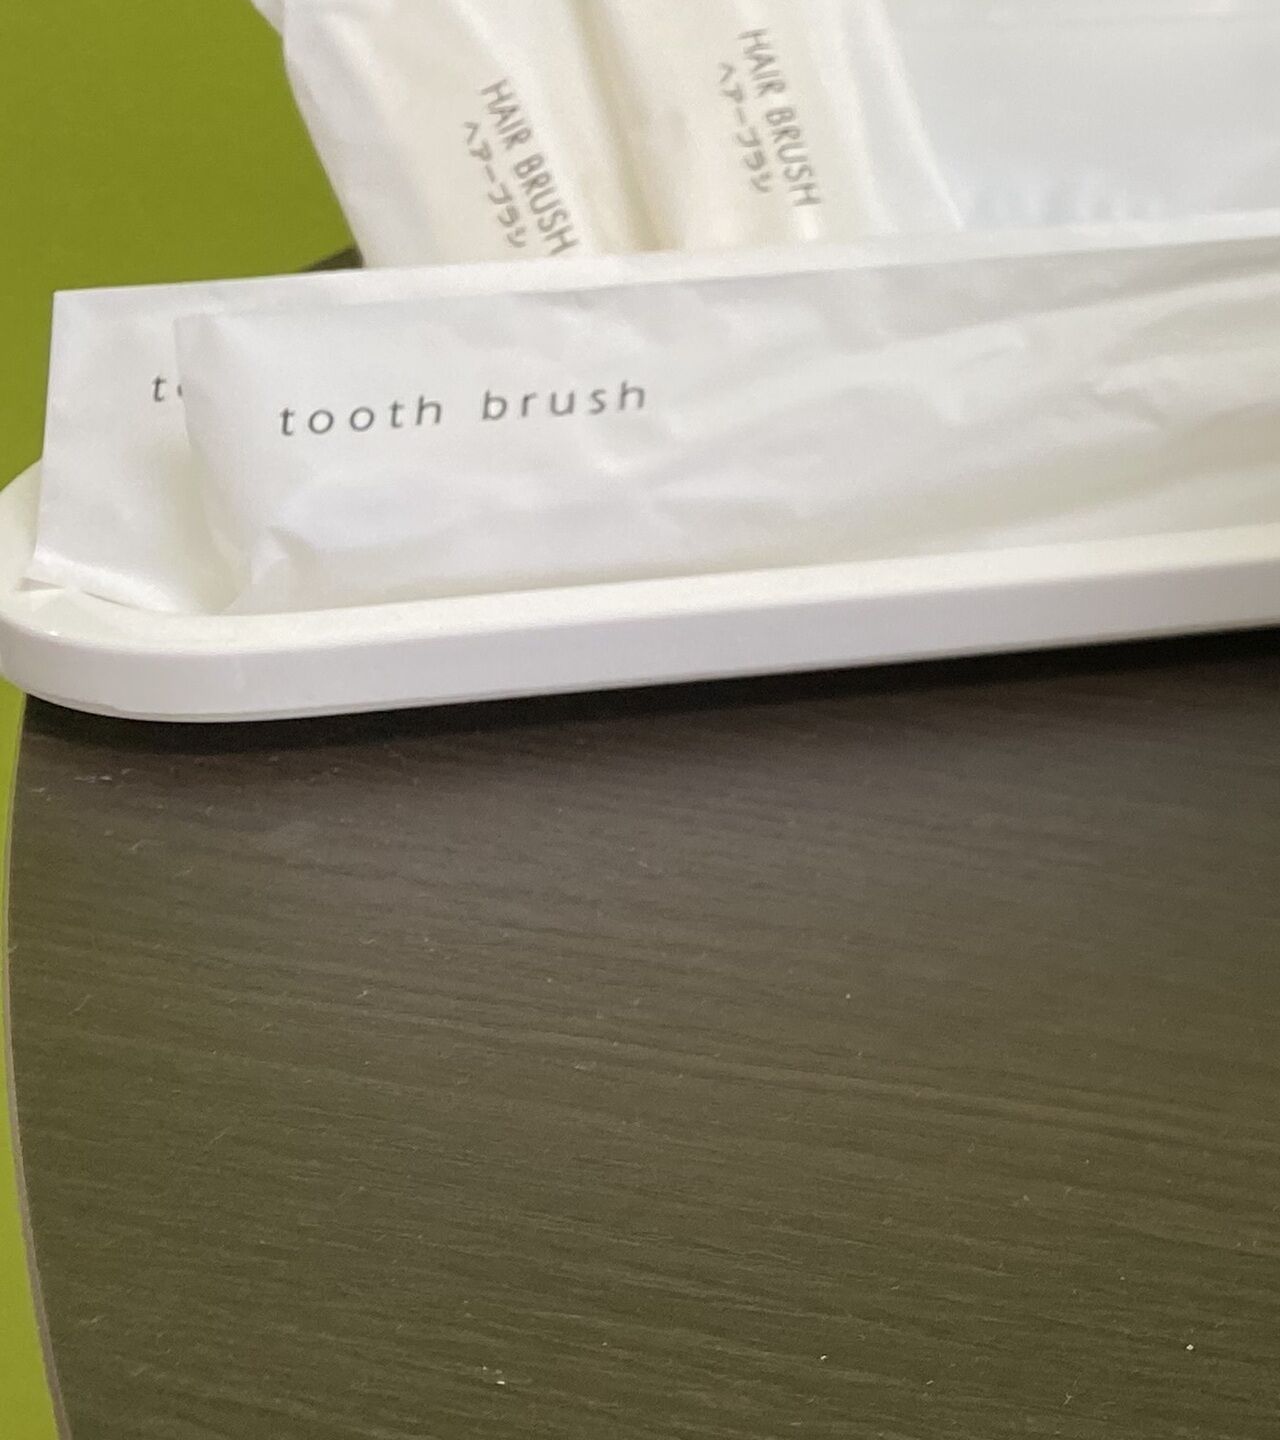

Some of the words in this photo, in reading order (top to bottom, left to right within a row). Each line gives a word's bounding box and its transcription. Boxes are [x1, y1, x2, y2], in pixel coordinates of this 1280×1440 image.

[481, 78, 532, 150] HAIR
[514, 153, 579, 255] BRUSH
[737, 28, 786, 97] HAIR
[766, 107, 822, 206] BRUSH
[279, 395, 442, 436] tooth
[481, 380, 646, 422] brush
